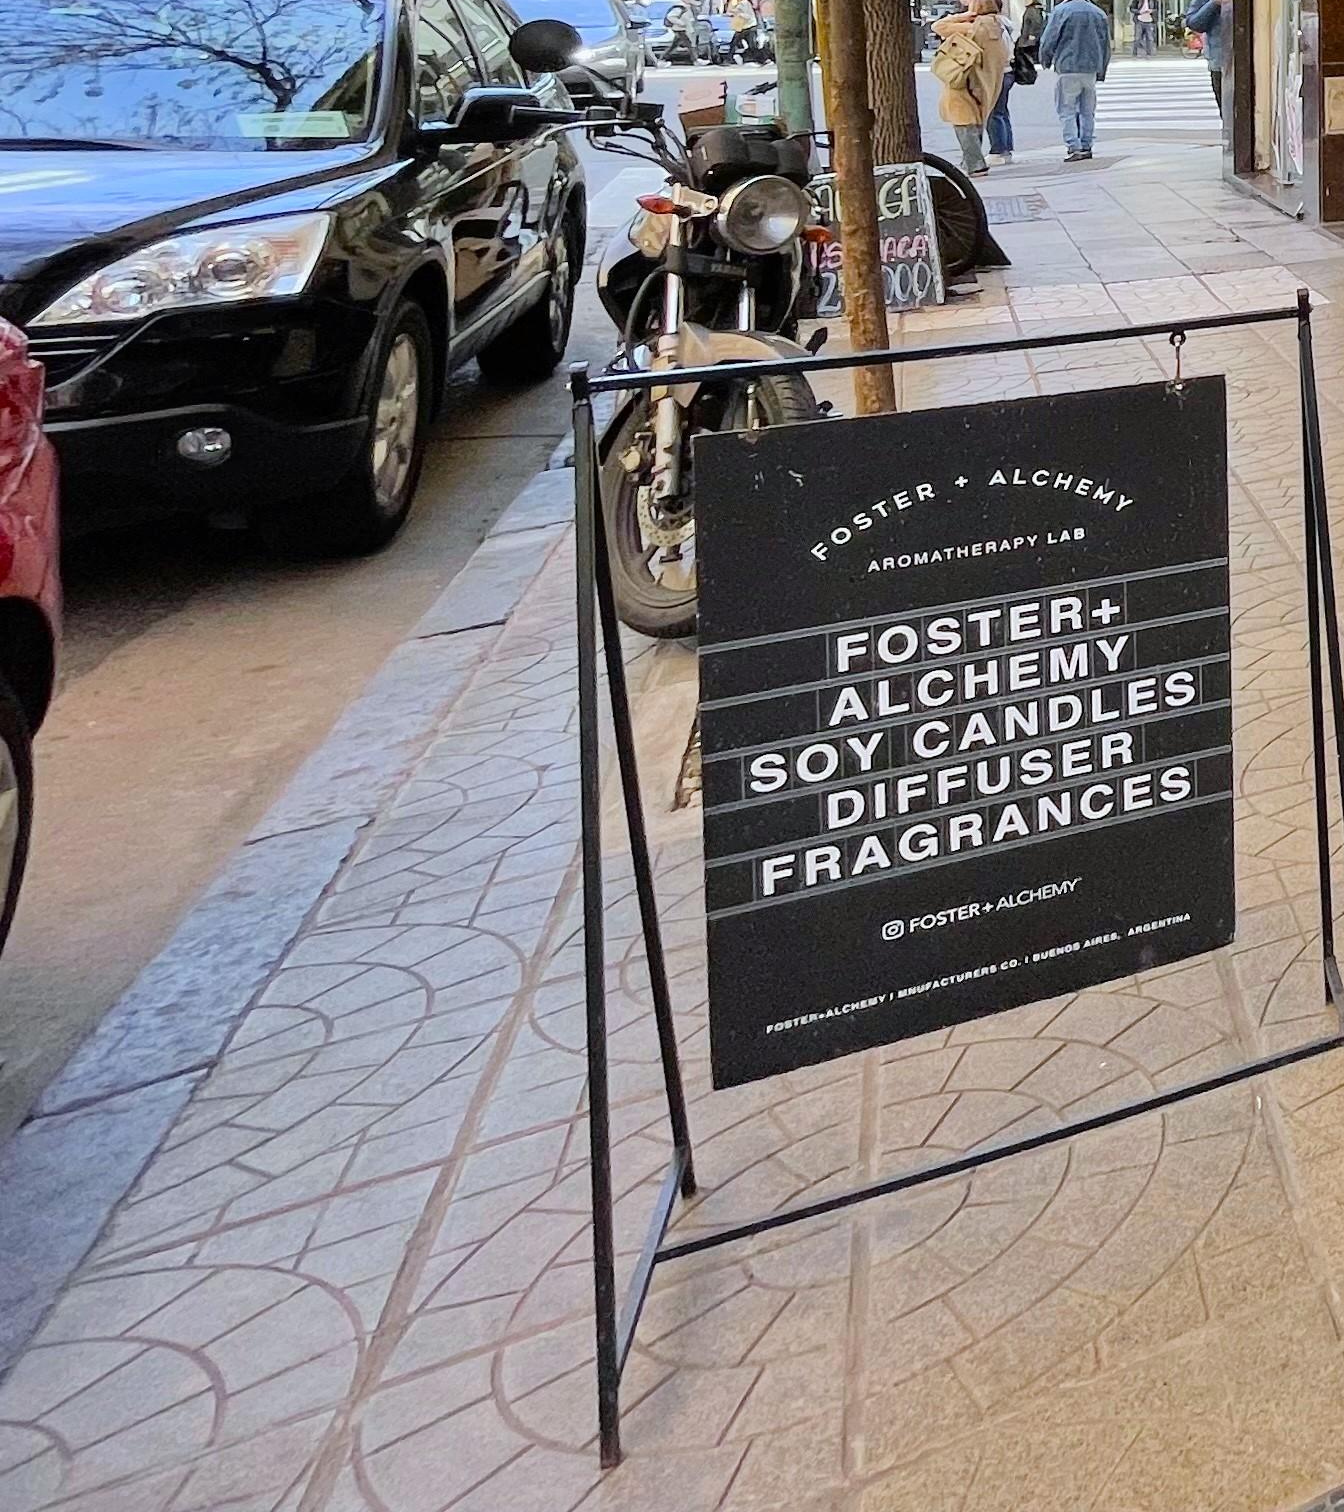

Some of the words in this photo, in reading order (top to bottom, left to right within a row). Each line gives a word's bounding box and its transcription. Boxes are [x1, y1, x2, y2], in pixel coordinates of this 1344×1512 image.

[811, 482, 936, 562] FOSTER
[954, 475, 970, 487] +
[989, 467, 1135, 514] ALCHEMY
[867, 535, 1039, 573] AROMATHERAPY
[1047, 527, 1086, 544] LAB
[828, 634, 1130, 727] ALCHEMY
[836, 594, 1121, 673] FOSTER+
[749, 732, 884, 793] SOY
[912, 669, 1198, 759] CANDLES
[826, 730, 1135, 830] DIFFUSER
[761, 766, 1193, 897] FRAGRANCES
[1000, 959, 1022, 971] CO.
[1032, 942, 1080, 962] BUENOS
[1127, 913, 1192, 937] ARGENTINA
